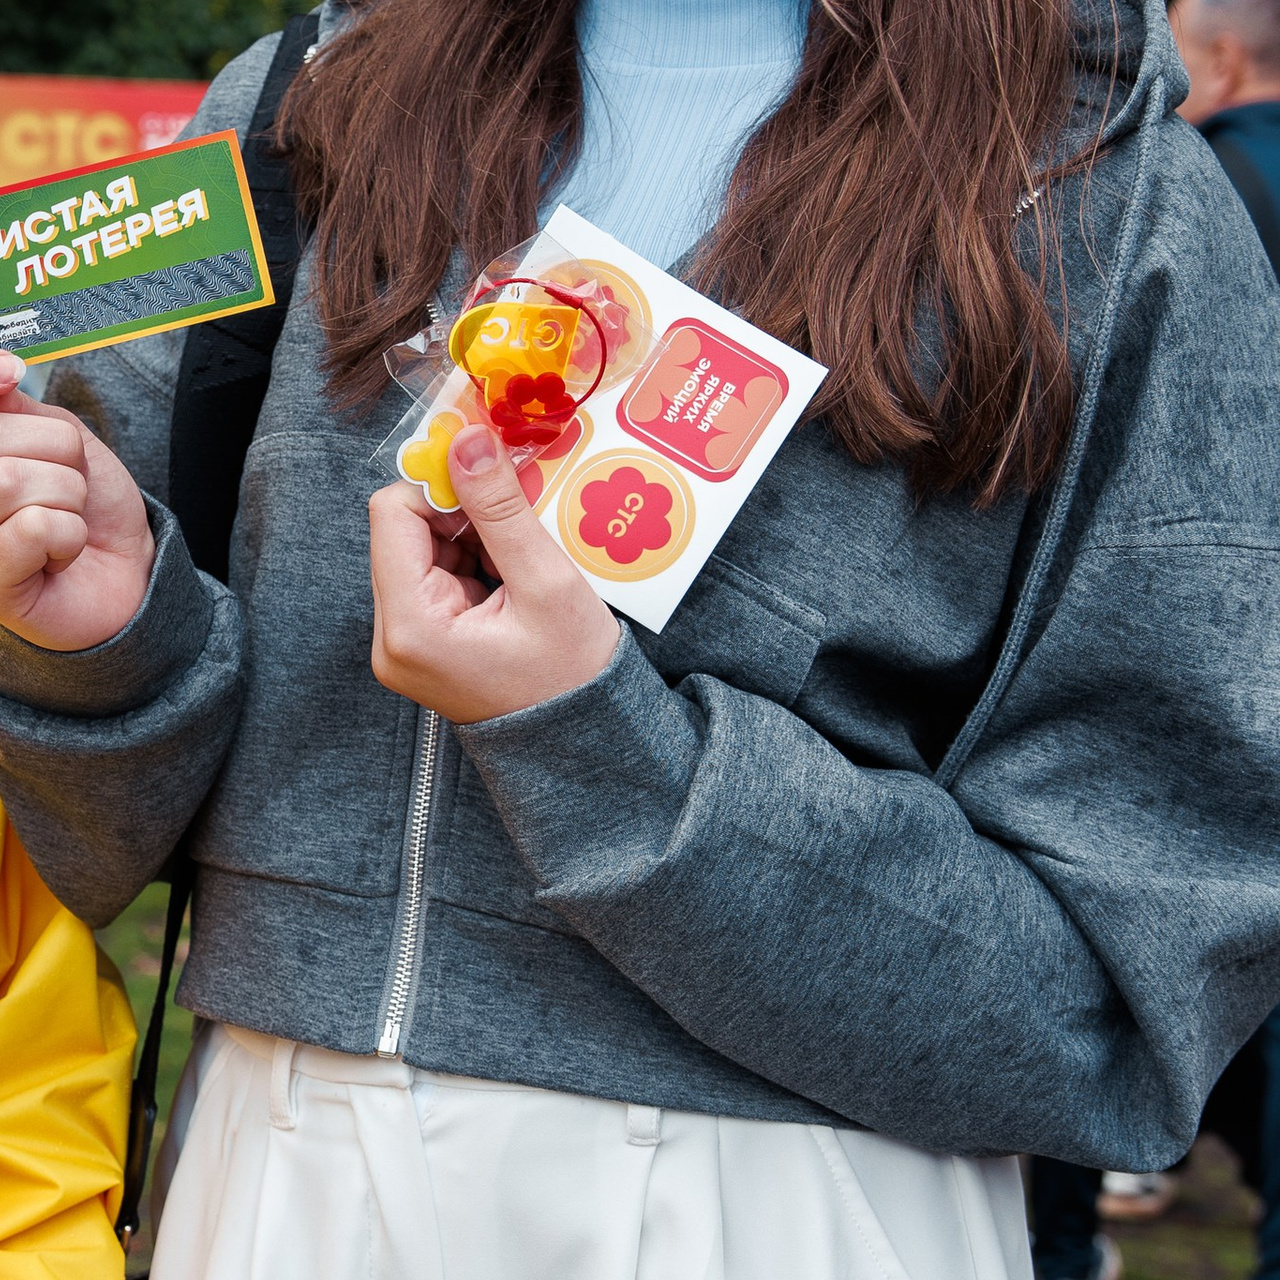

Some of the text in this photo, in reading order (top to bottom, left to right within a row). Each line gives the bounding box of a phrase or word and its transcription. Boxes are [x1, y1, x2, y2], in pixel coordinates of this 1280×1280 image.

[0, 108, 136, 168] СТС
[15, 188, 208, 295] ЛОТЕРЕЯ
[480, 317, 565, 352] СТС
[663, 357, 712, 424] ЭМОЦИЙ
[682, 374, 720, 424] ЯРКИХ
[697, 381, 736, 433] ВРЕМЯ
[607, 492, 644, 538] СТС
